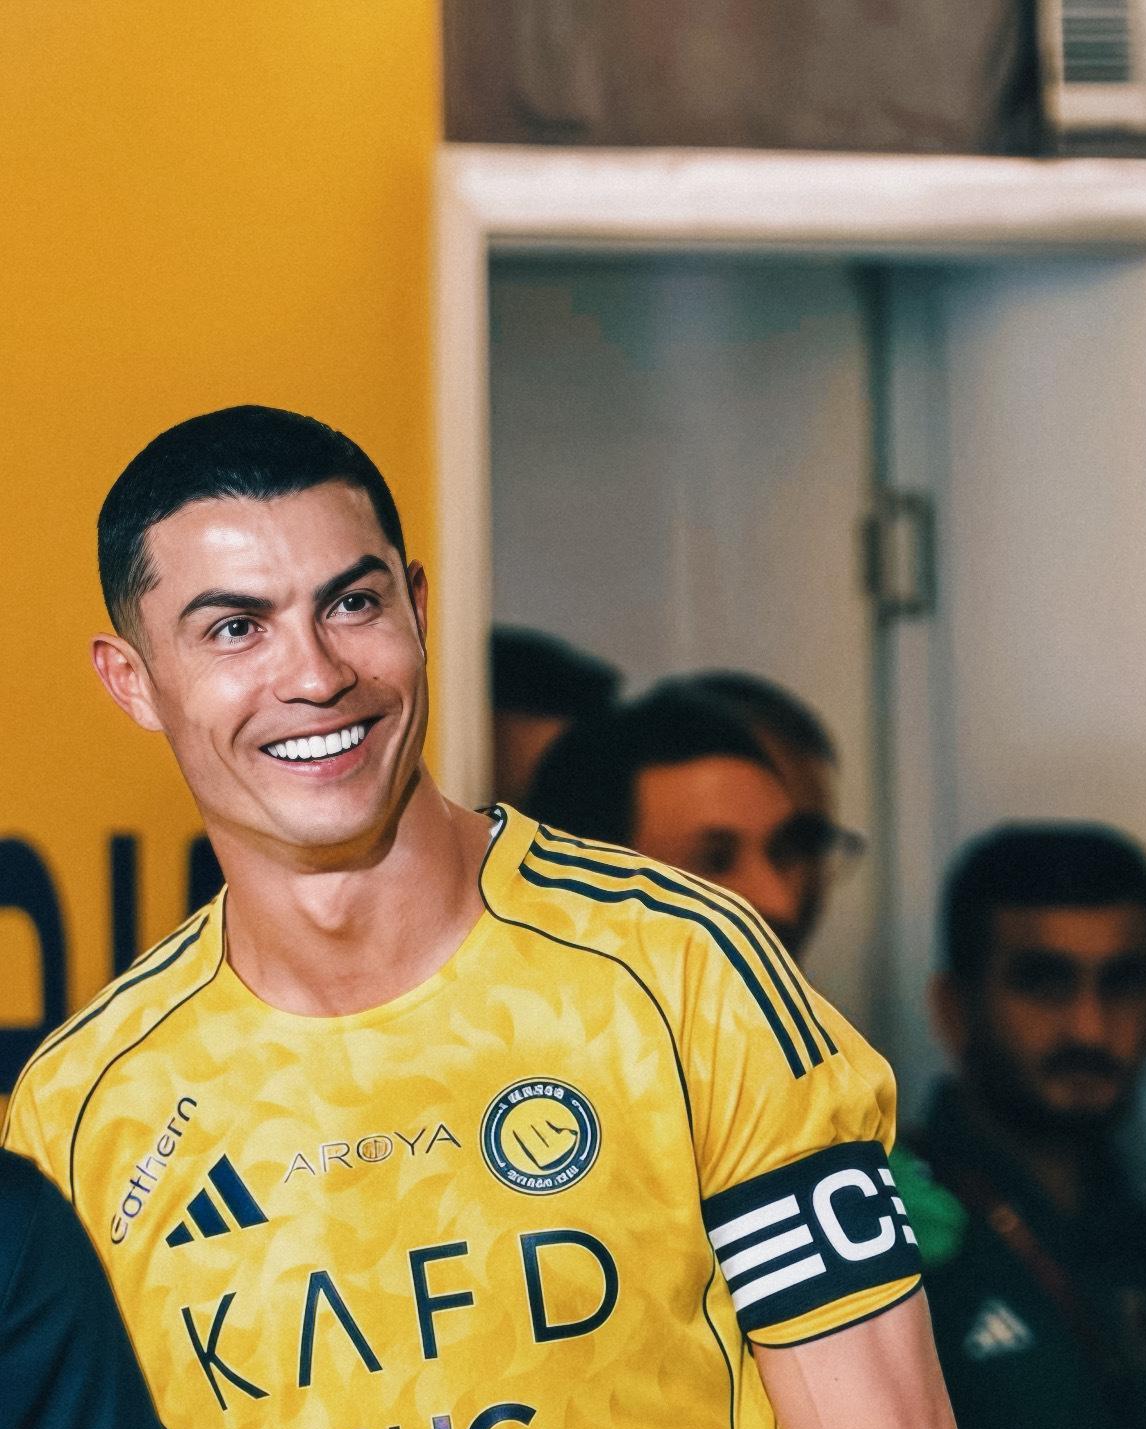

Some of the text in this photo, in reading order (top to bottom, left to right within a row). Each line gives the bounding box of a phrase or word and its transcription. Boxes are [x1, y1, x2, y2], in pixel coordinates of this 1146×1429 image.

[283, 1123, 463, 1184] AROYA
[812, 1168, 896, 1262] C
[180, 1228, 620, 1412] KAFD
